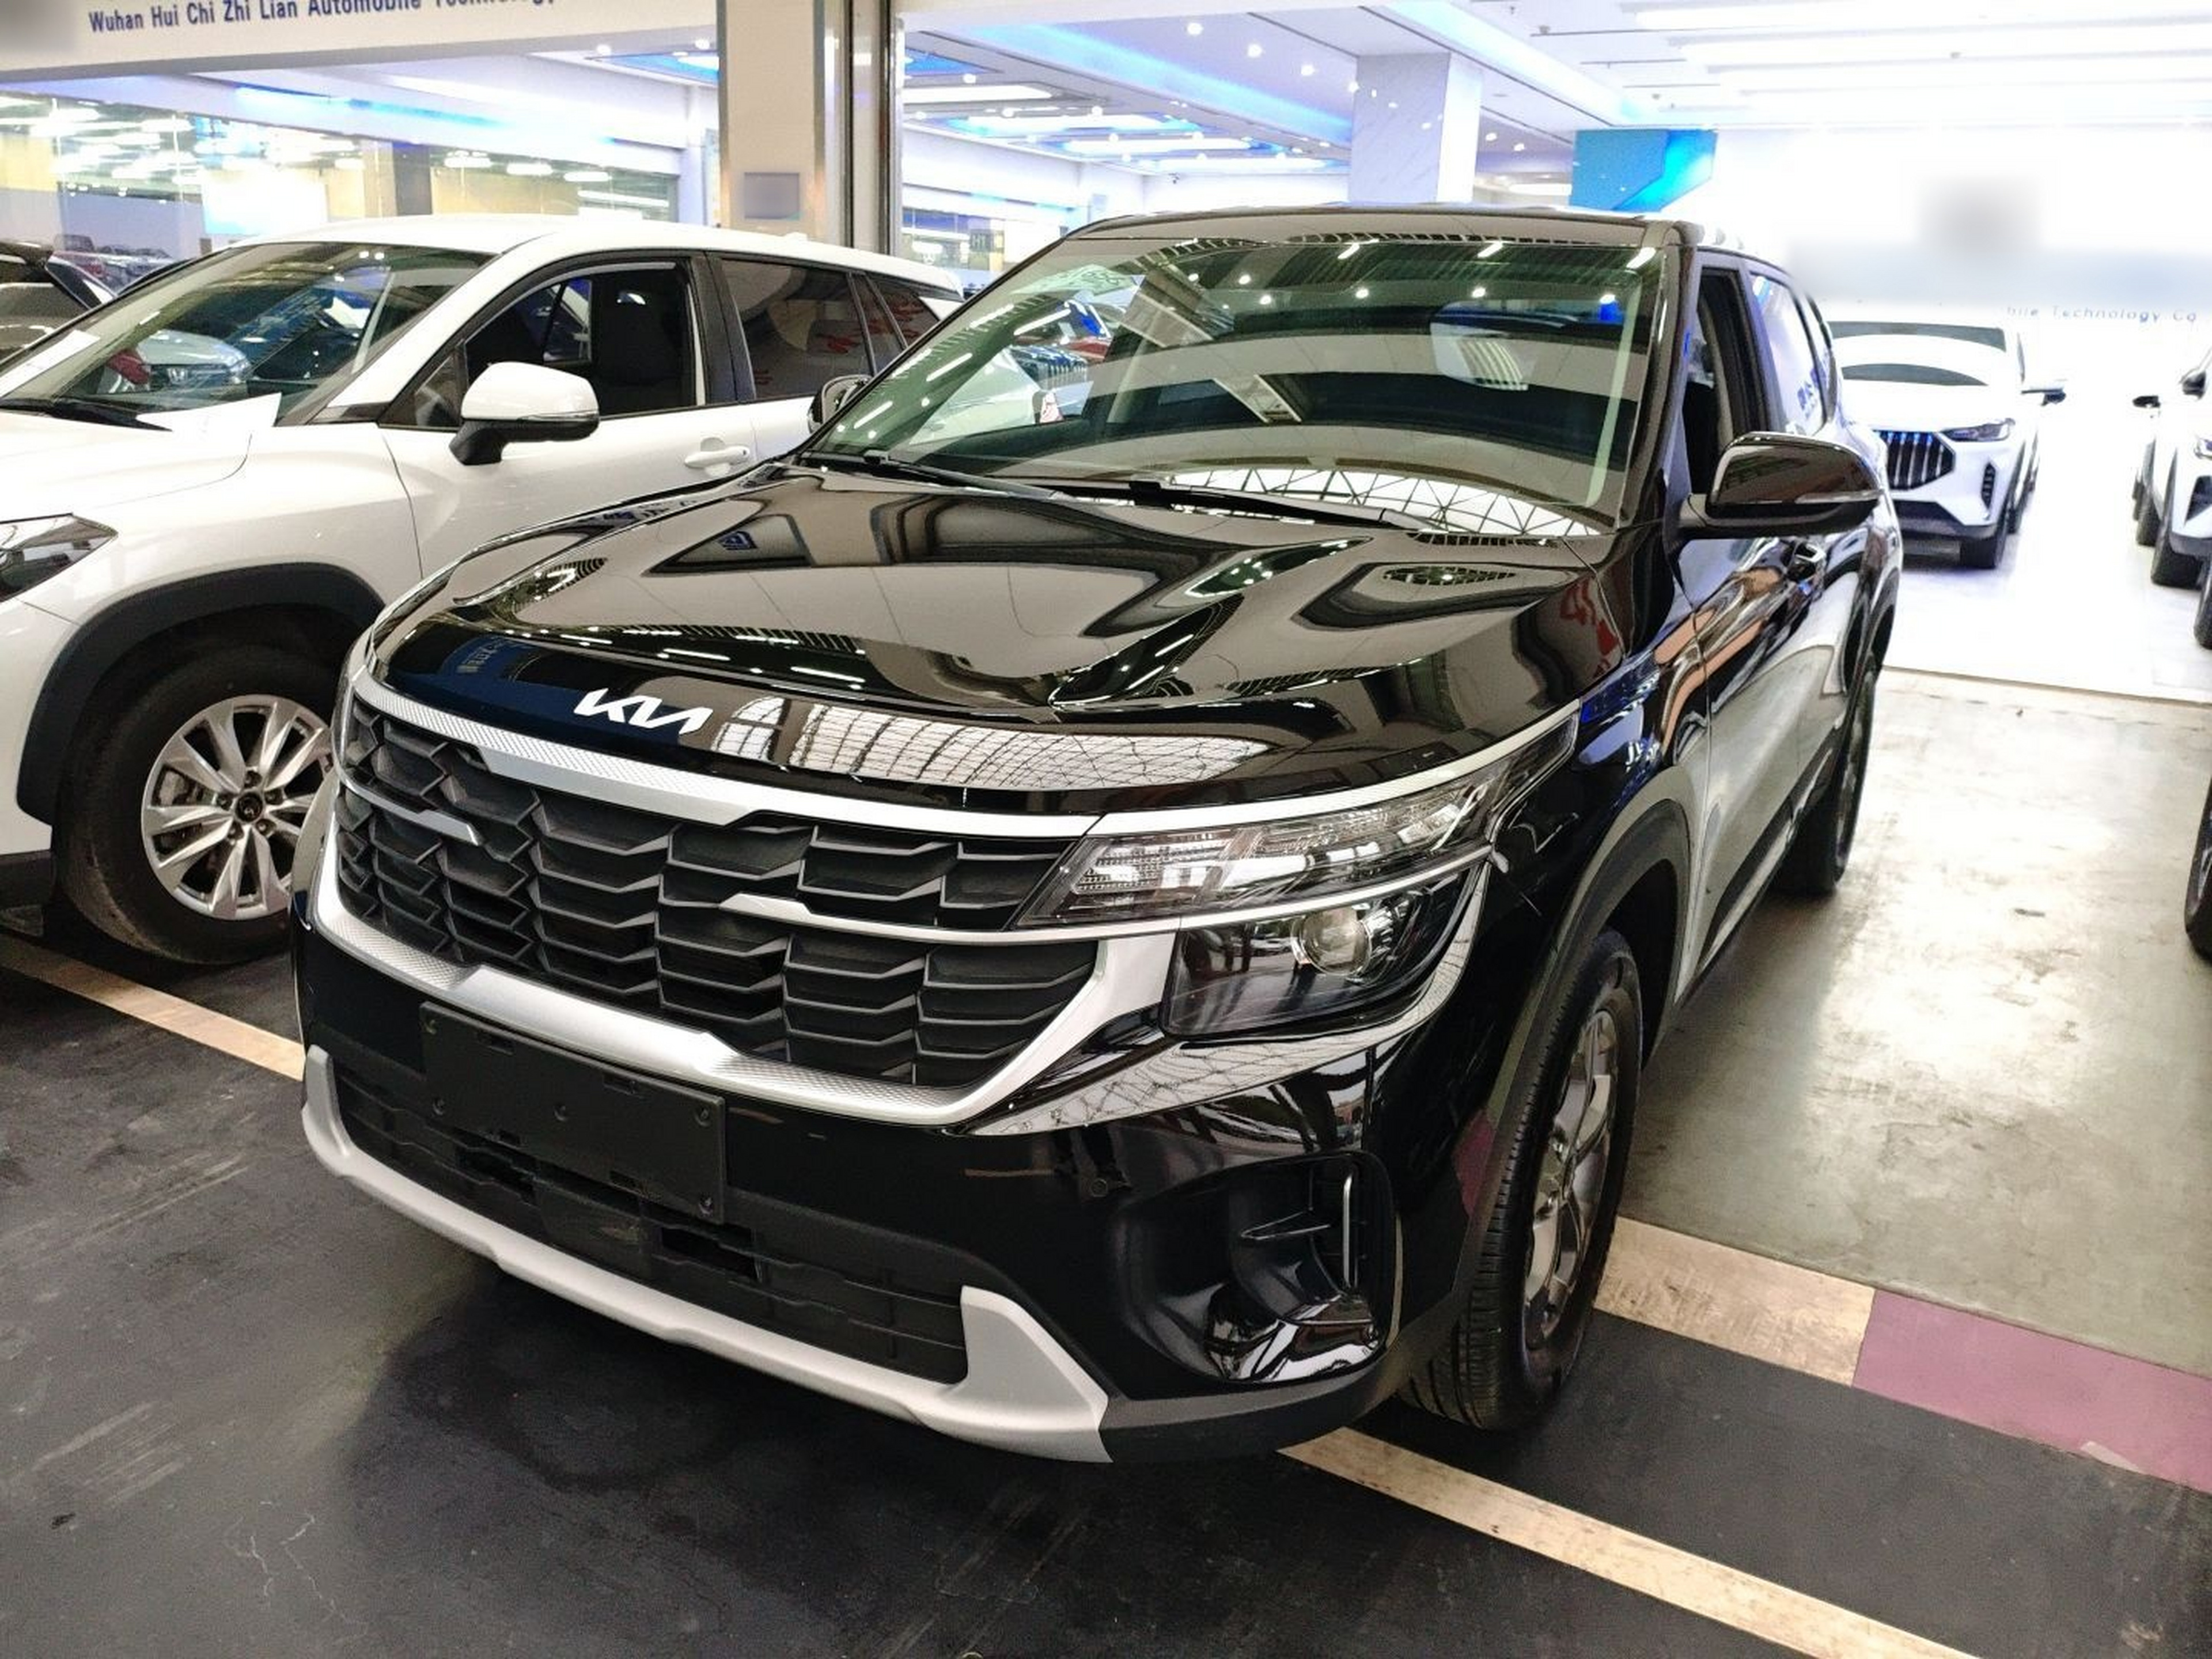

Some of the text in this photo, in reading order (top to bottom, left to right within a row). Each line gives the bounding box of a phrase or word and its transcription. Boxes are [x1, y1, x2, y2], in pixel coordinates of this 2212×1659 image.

[89, 10, 143, 32] Wuhan
[151, 5, 180, 28] Hui
[187, 1, 215, 25] Chi
[224, 0, 251, 22] Zhi
[260, 0, 298, 19] Lian
[2052, 305, 2160, 323] Technology
